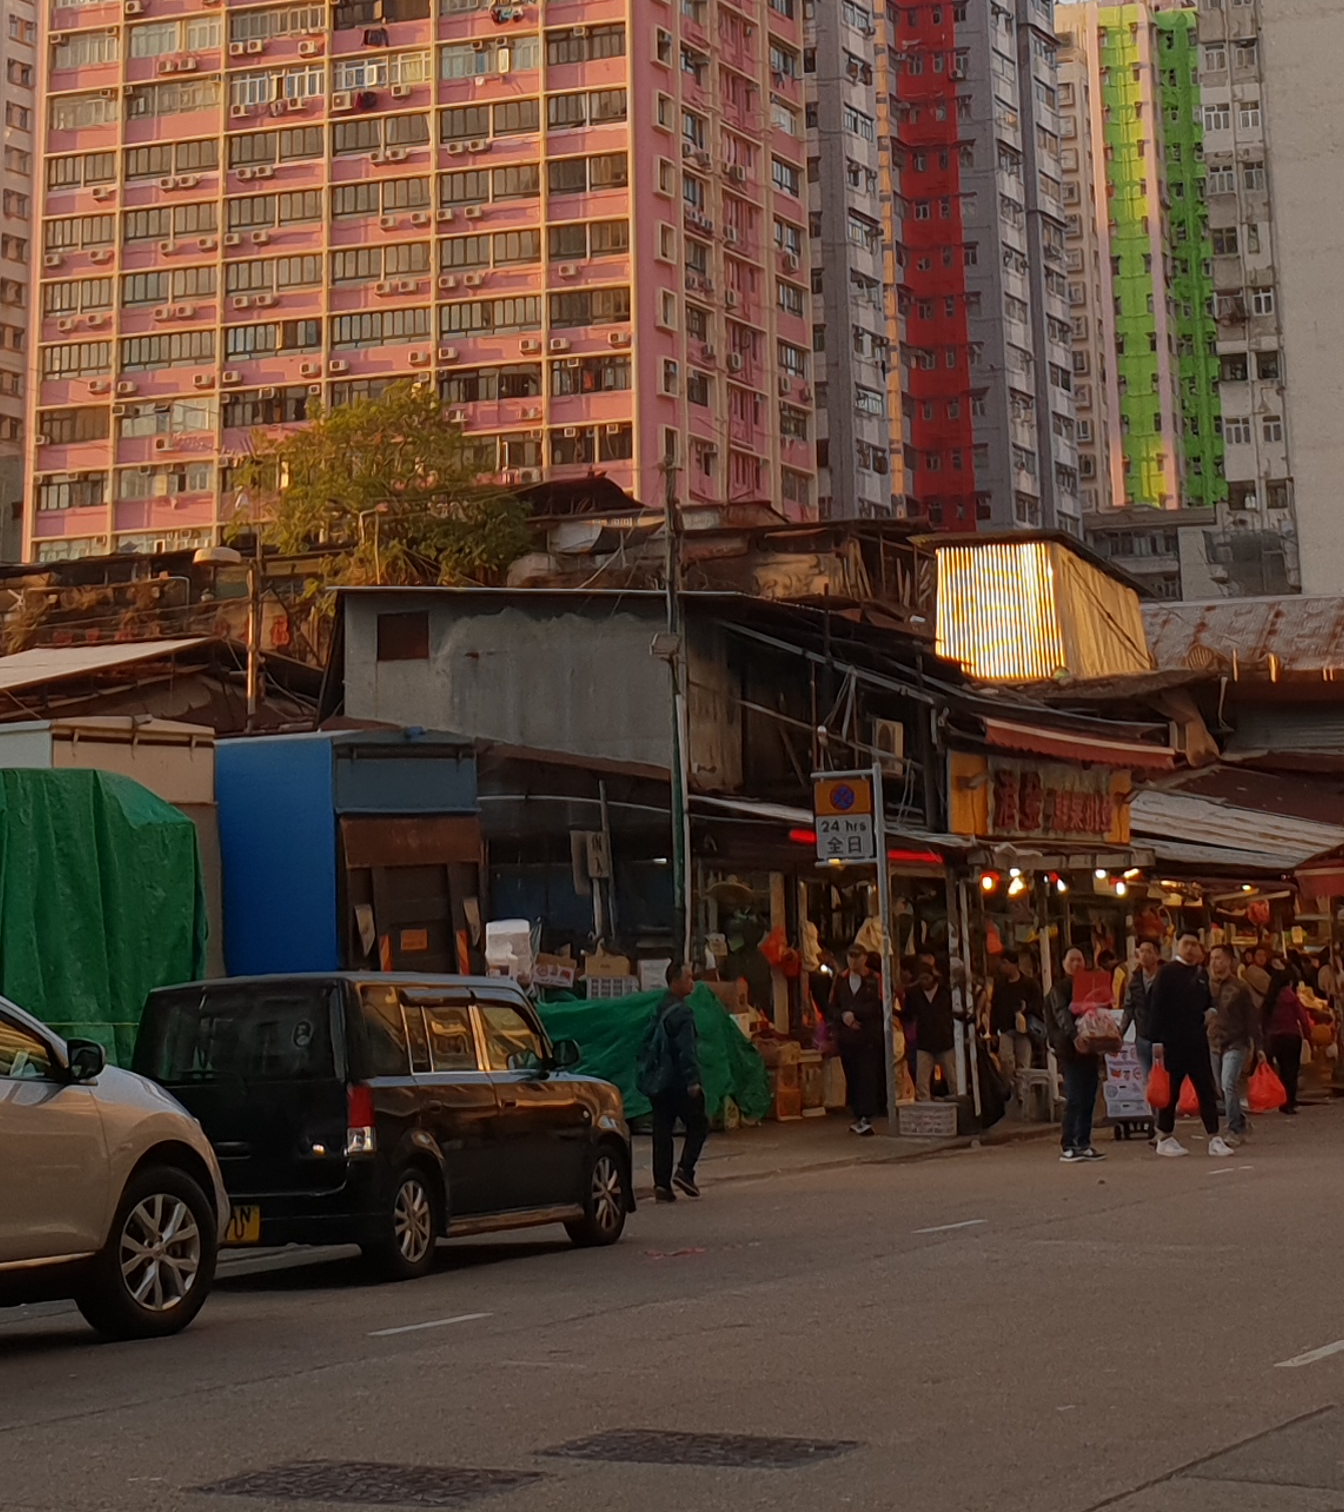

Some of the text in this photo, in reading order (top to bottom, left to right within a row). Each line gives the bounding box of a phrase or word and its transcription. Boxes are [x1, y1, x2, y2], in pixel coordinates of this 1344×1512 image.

[821, 819, 866, 833] 24 hrs
[827, 835, 862, 855] 全日
